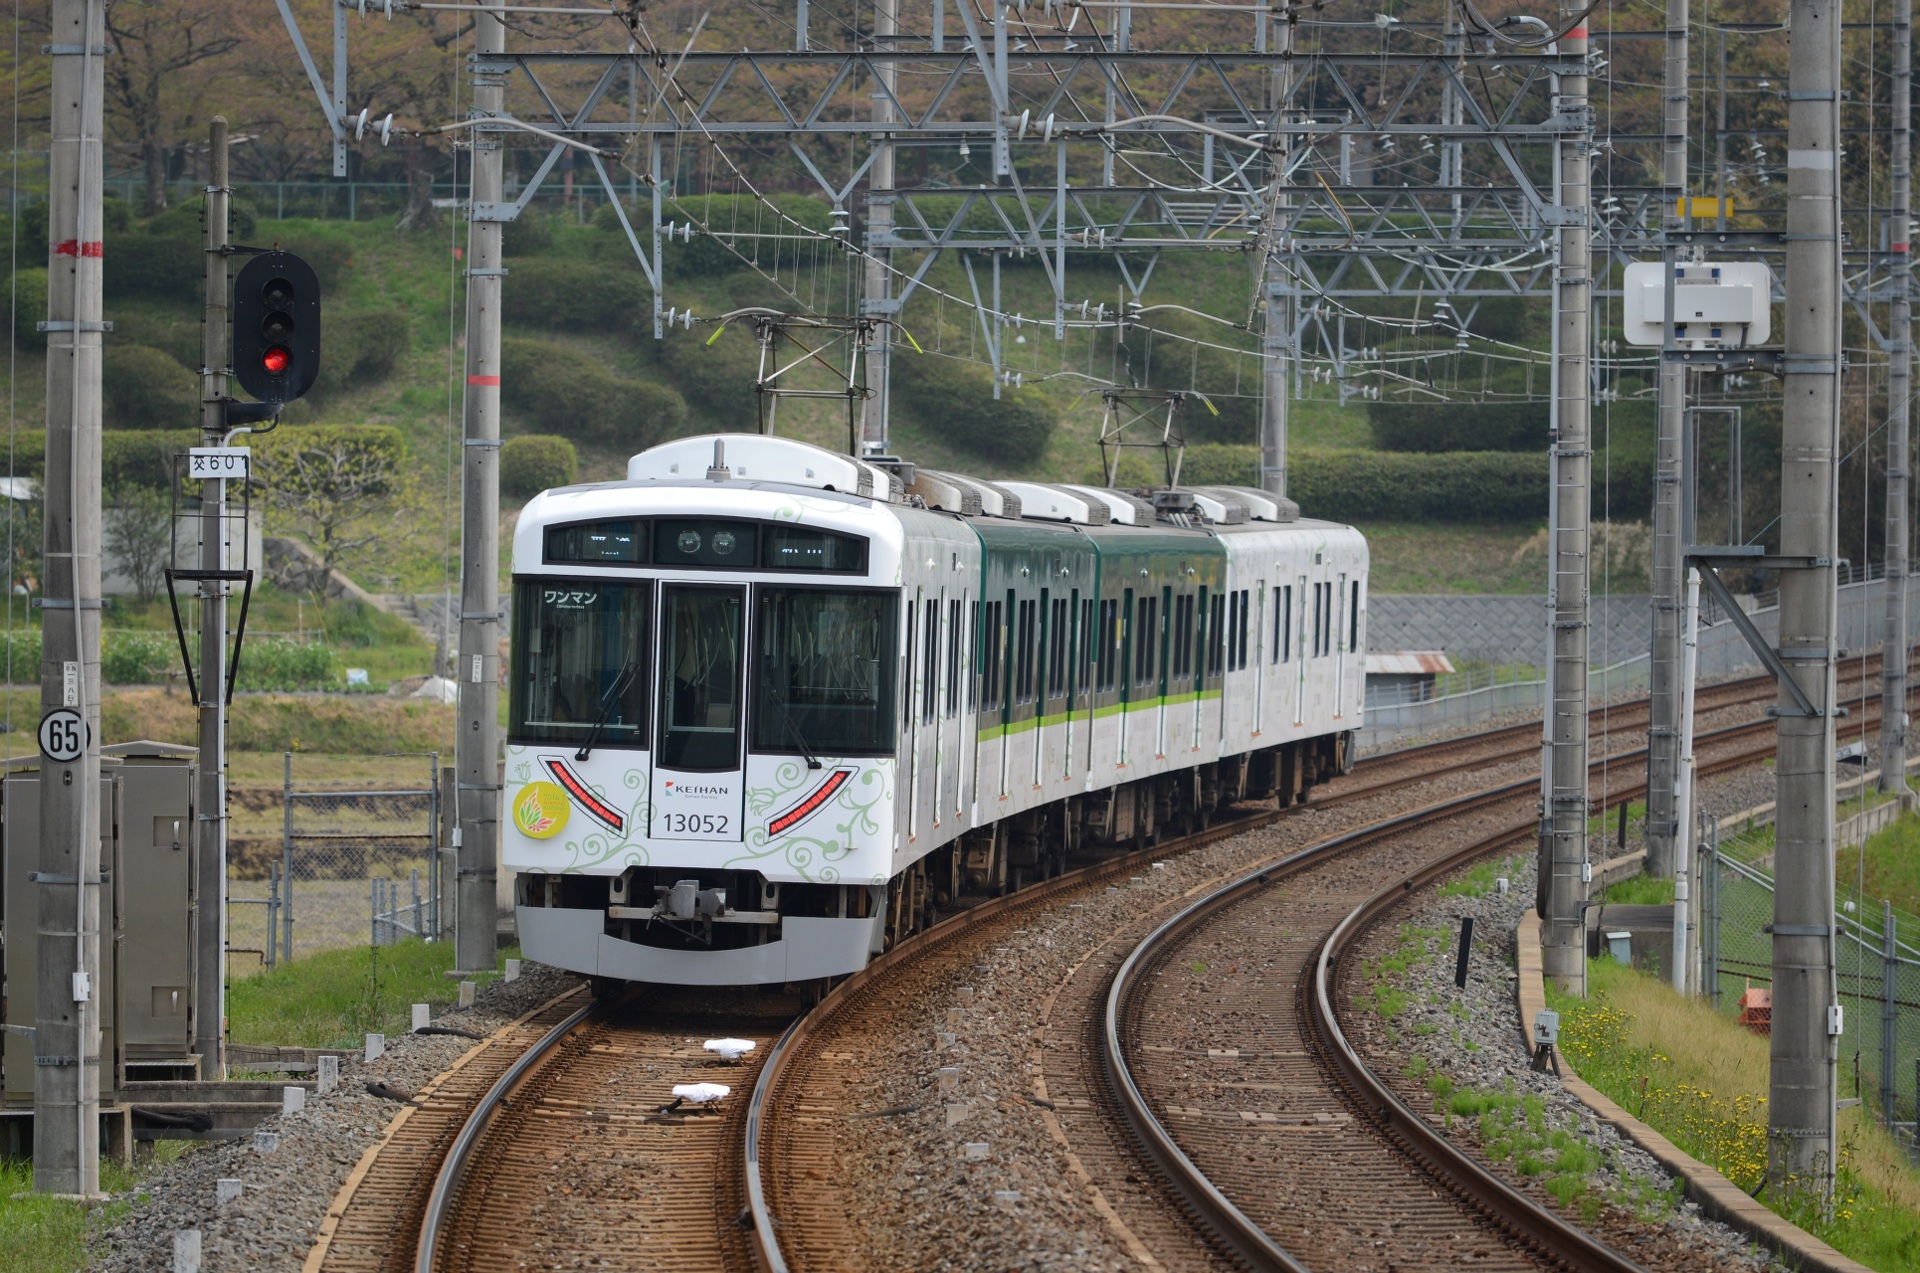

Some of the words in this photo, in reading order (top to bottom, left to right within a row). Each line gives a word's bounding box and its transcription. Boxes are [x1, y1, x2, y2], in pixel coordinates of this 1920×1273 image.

[544, 590, 598, 604] ワンマン
[49, 719, 79, 753] 65
[675, 785, 728, 794] KEIHAN
[663, 813, 729, 834] 13052
